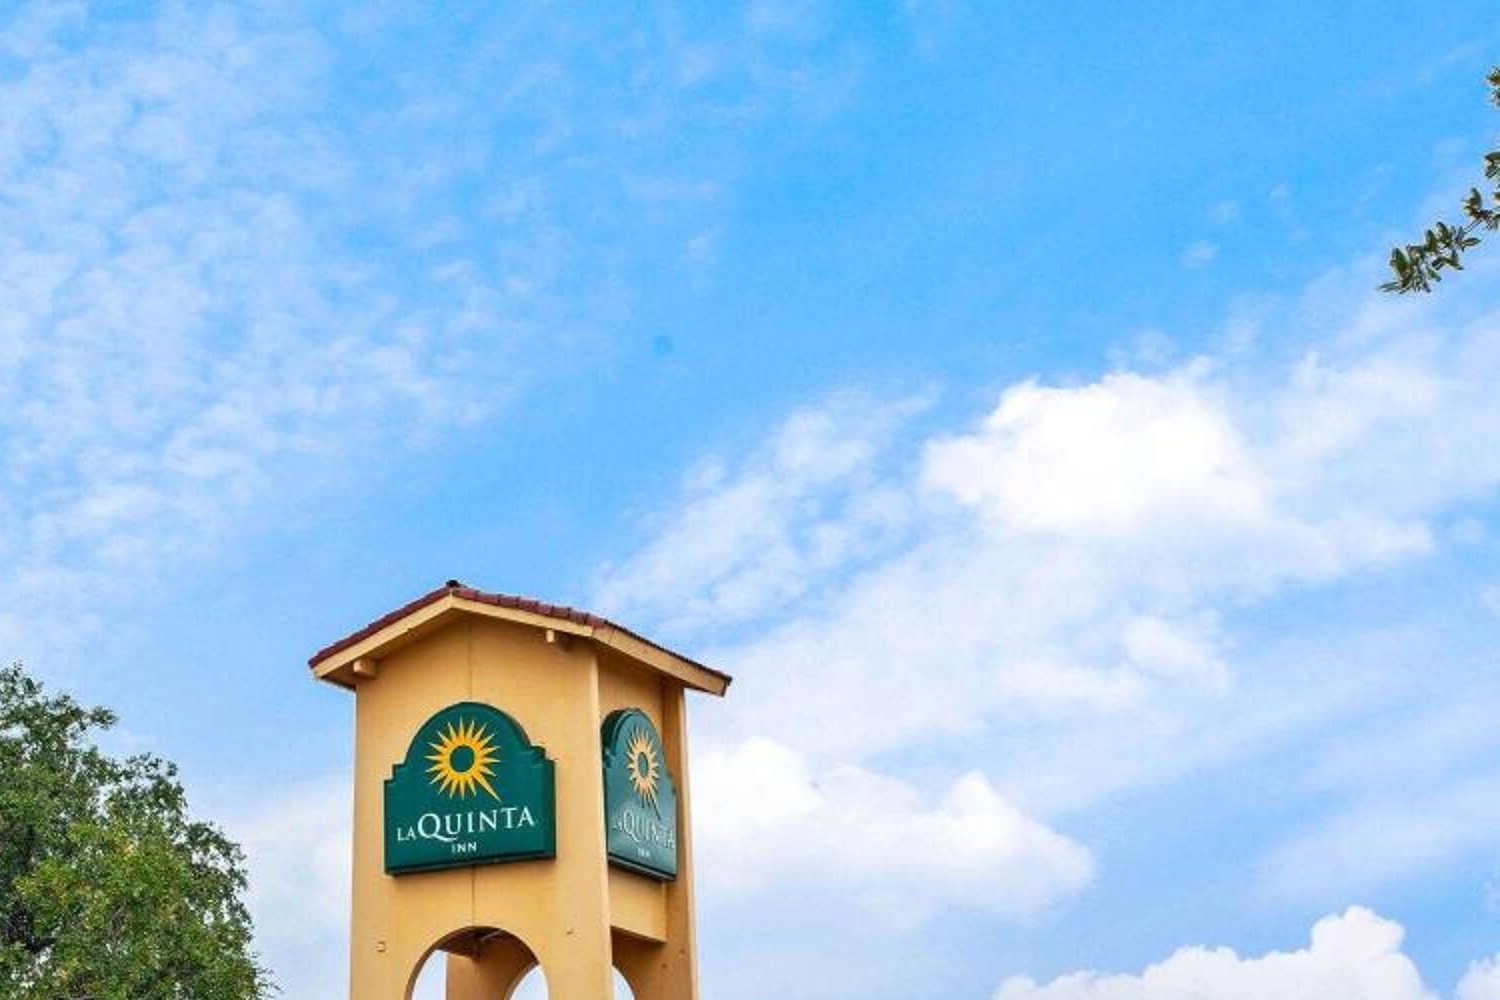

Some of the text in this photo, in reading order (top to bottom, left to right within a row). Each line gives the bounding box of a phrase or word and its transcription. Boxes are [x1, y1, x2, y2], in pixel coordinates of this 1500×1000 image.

[397, 806, 535, 842] LA QUINTA
[451, 841, 477, 854] INN
